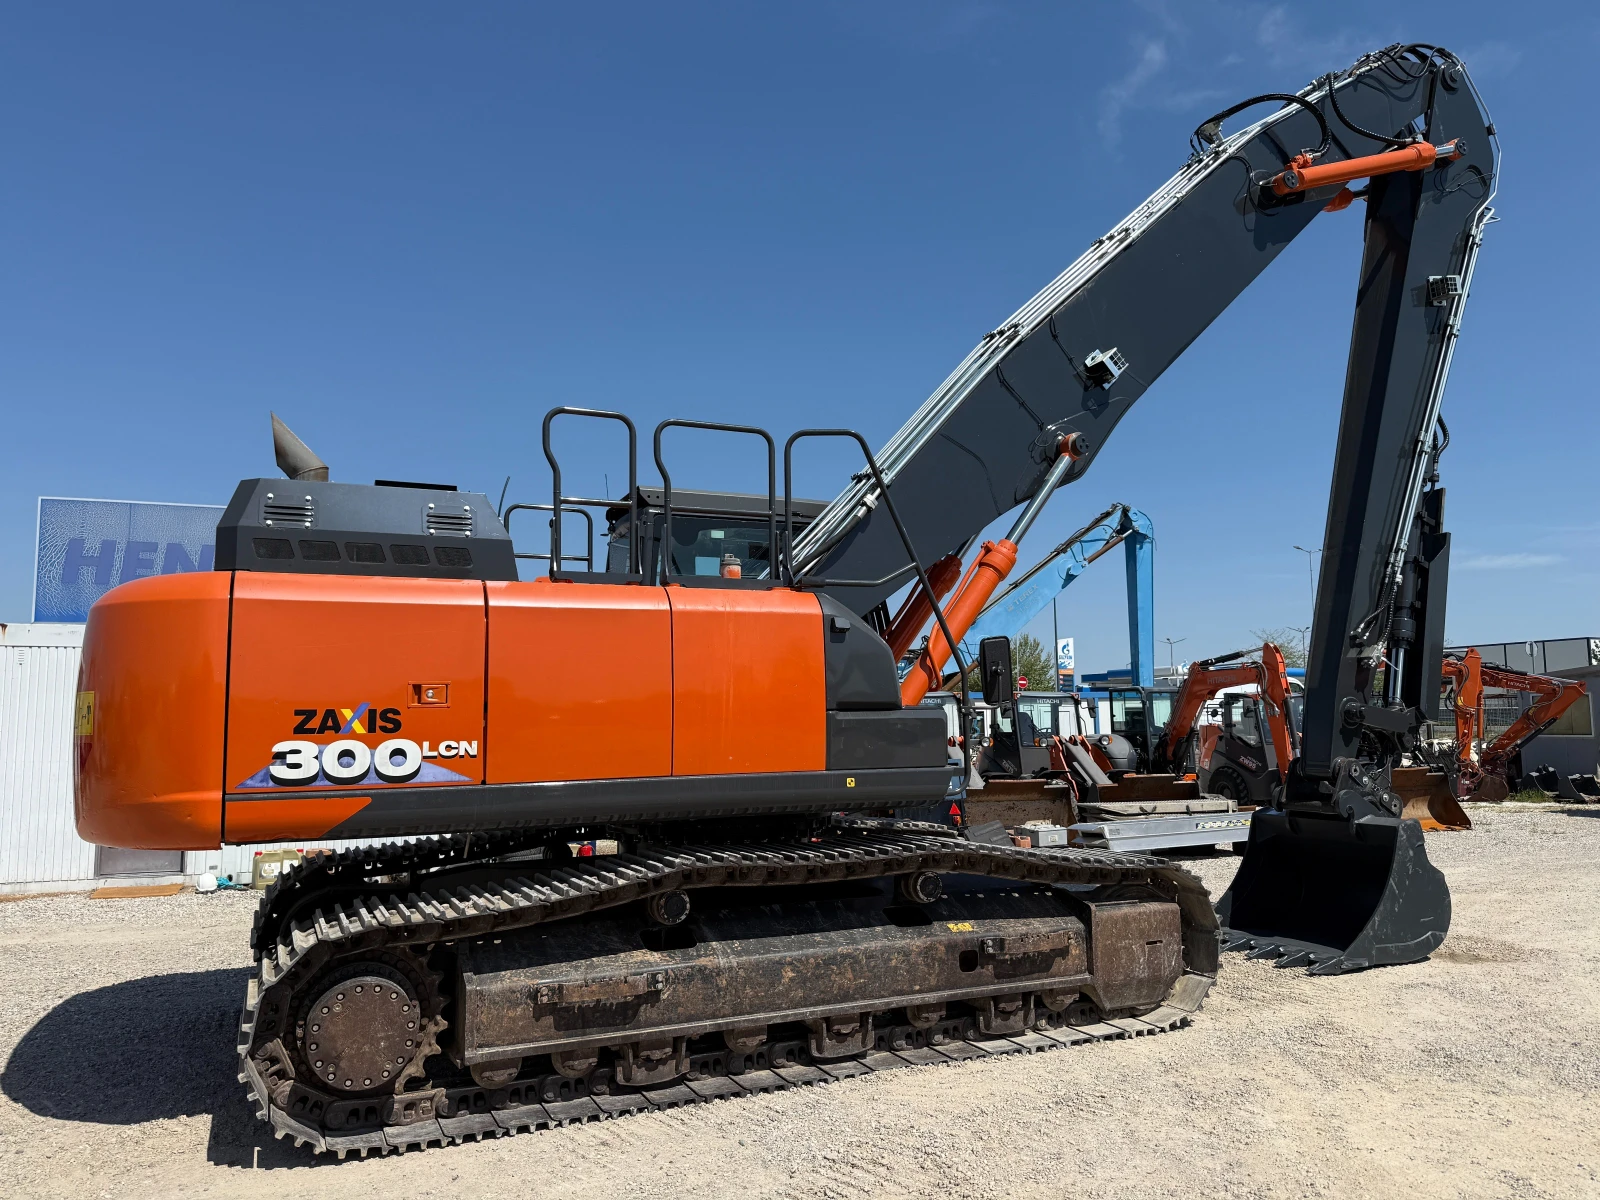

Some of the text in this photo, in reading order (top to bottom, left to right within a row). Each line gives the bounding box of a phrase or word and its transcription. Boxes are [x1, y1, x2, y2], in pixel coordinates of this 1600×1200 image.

[1013, 583, 1039, 606] TEREX
[1207, 675, 1237, 685] HITACHI
[293, 702, 402, 735] ZAXIS
[269, 738, 478, 786] 300 LCN
